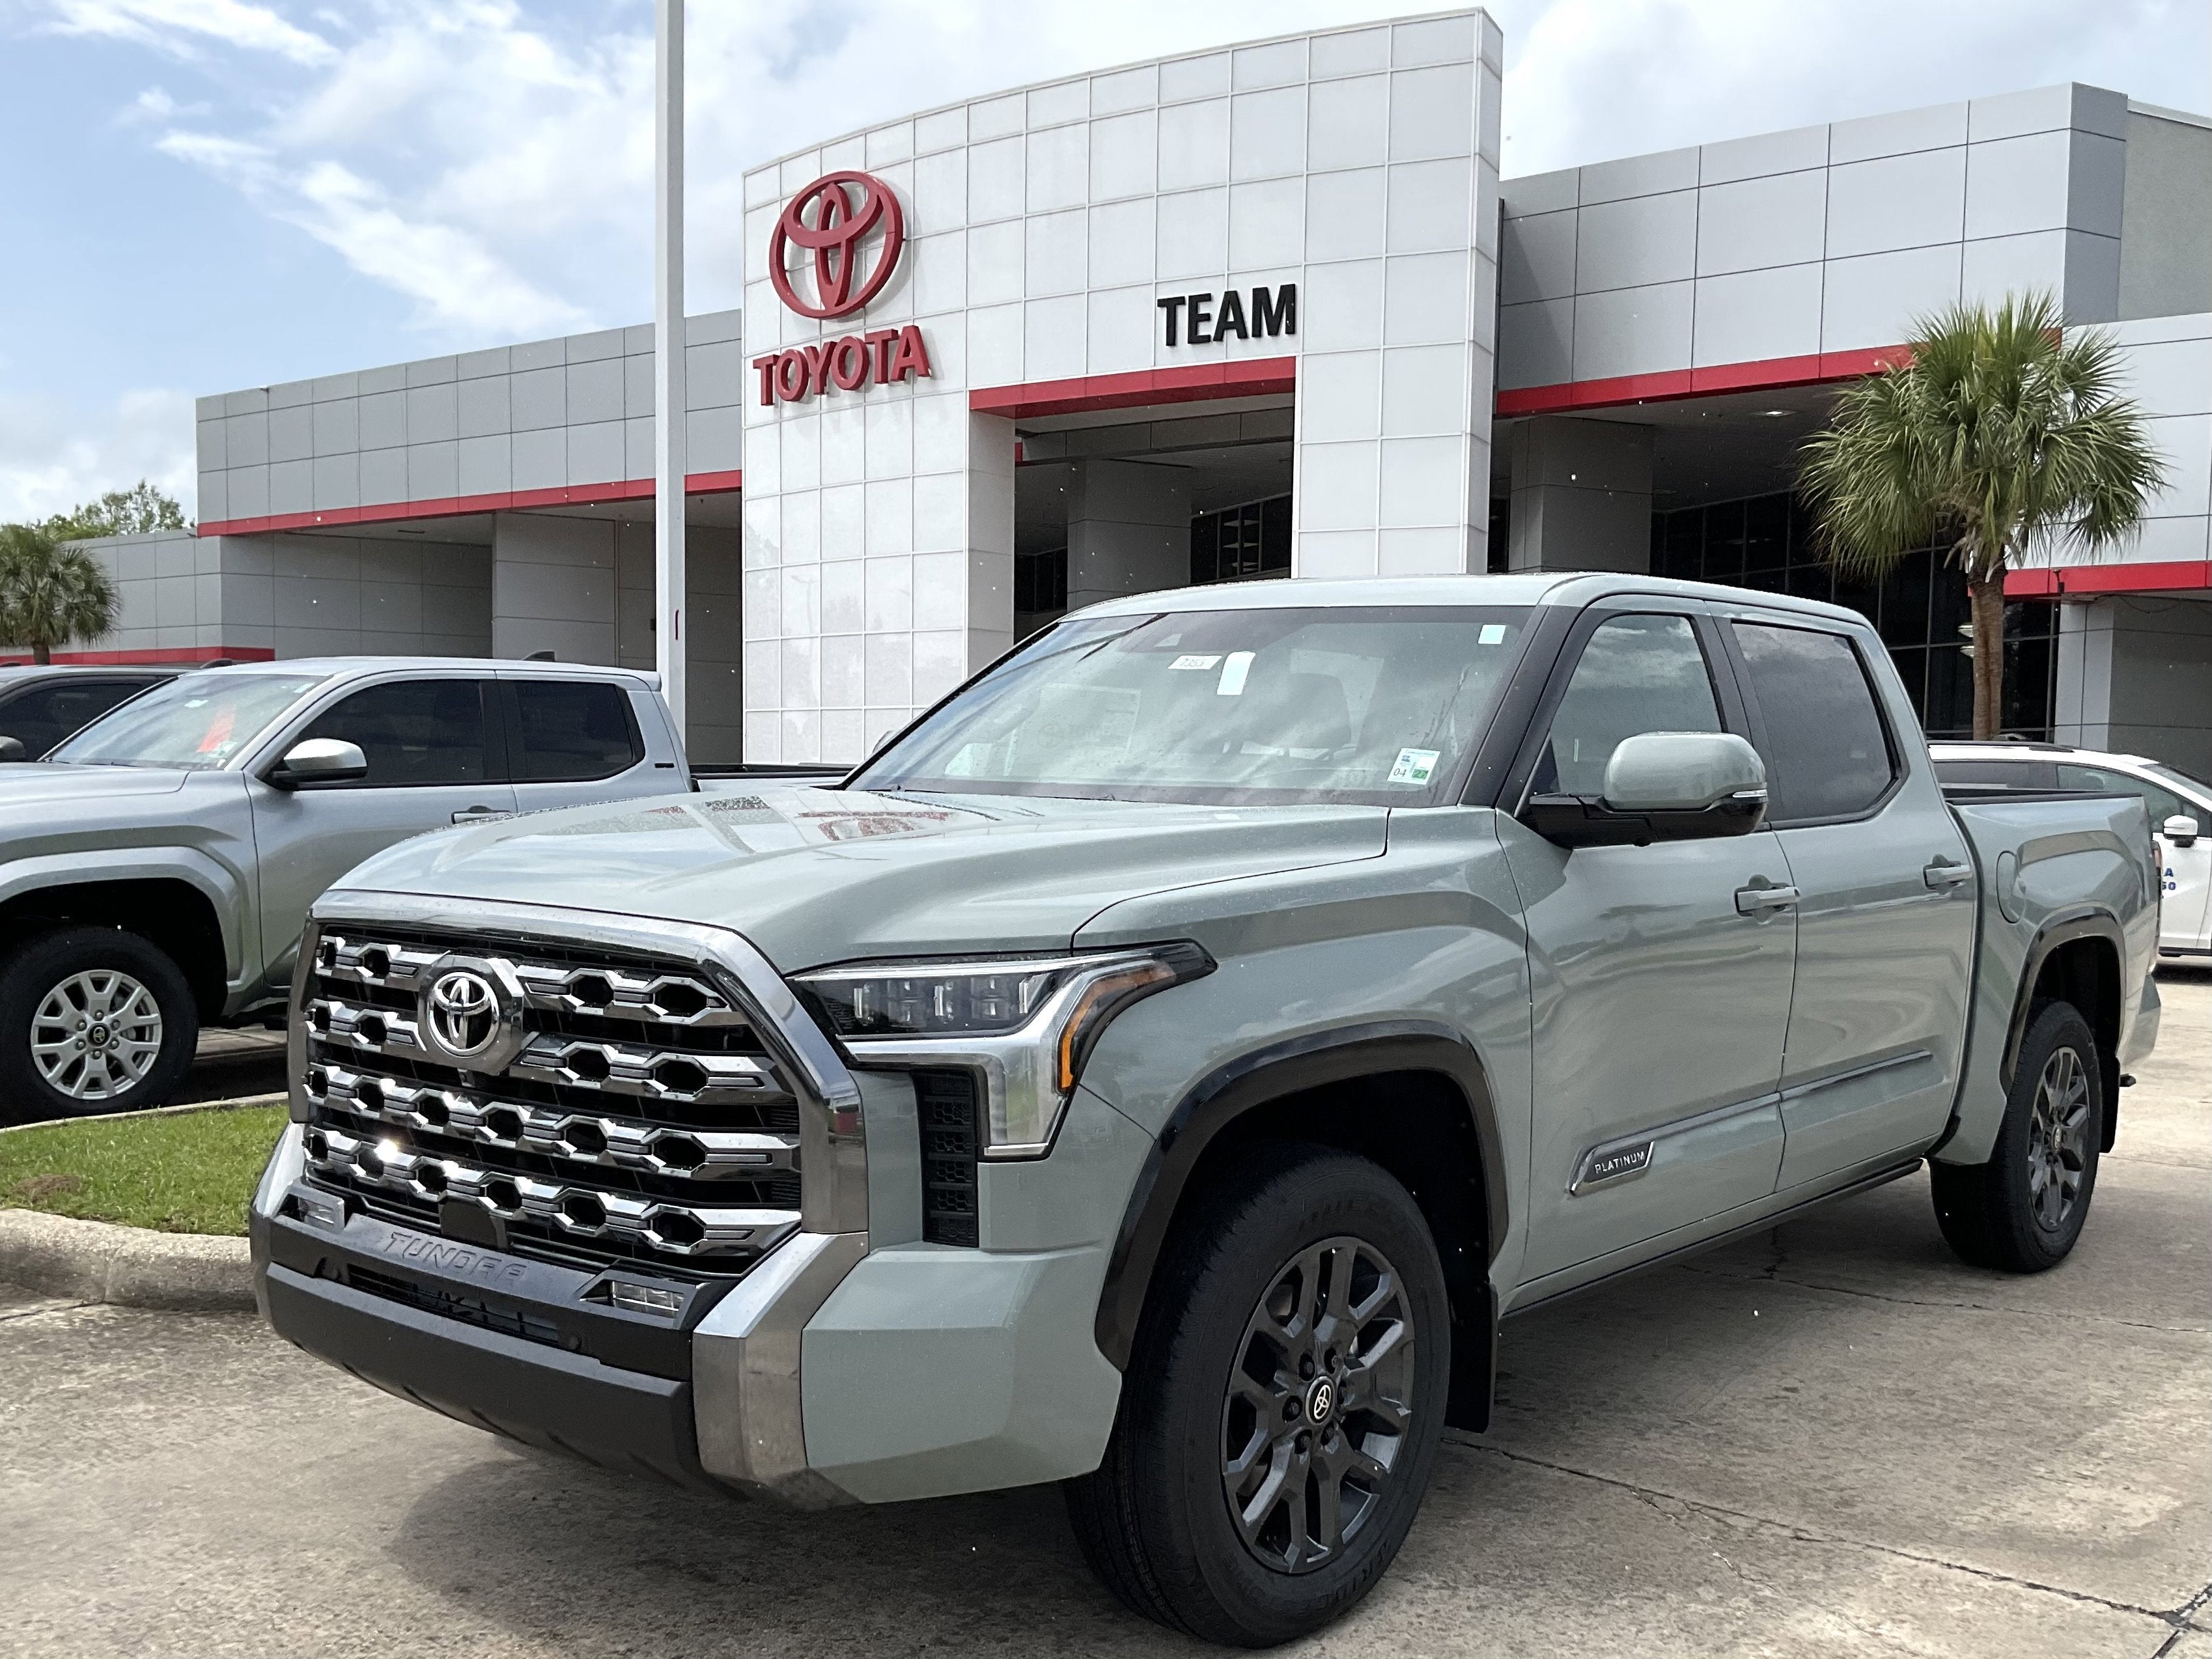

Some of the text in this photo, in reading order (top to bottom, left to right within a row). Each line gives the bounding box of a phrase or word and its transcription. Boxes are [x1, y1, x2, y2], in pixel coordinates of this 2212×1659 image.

[1157, 283, 1296, 346] TEAM
[753, 325, 931, 406] TOYOTA
[1393, 768, 1407, 777] 04
[1595, 1151, 1645, 1174] PLATINUM
[384, 1231, 528, 1283] TUNDRA
